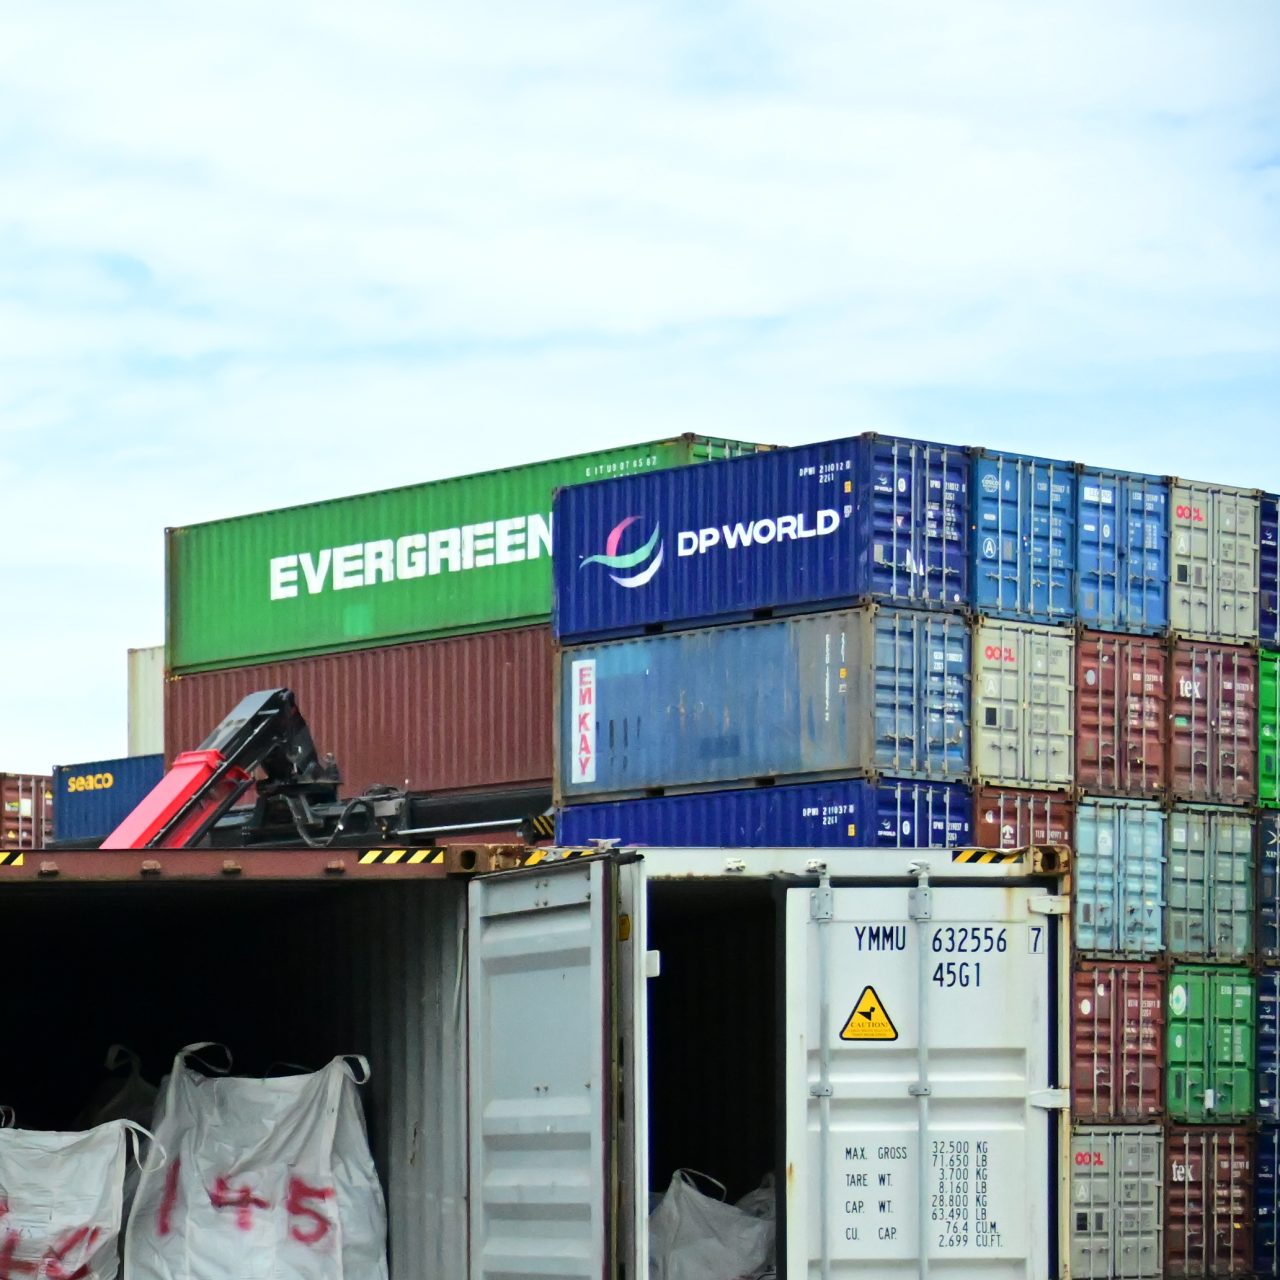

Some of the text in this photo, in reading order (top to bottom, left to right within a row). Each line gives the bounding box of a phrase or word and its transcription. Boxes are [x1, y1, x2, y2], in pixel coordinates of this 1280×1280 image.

[677, 508, 841, 557] DP WORLD
[270, 511, 553, 601] EVERGREEN
[984, 645, 1016, 663] OOCL
[1179, 675, 1201, 699] tex
[67, 772, 114, 793] seaco
[854, 925, 1042, 953] YMMU 632556 7
[932, 962, 981, 988] 45G1
[845, 1146, 908, 1160] MAX. GROSS
[932, 1141, 989, 1154] 32.500 KG
[932, 1154, 988, 1167] 71.650 LB
[939, 1168, 988, 1181] 3.700 KG
[1171, 1159, 1194, 1182] tex
[845, 1173, 893, 1187] TARE WT.
[938, 1181, 987, 1194] 8.160 LB
[845, 1200, 894, 1214] CAP. WT.
[931, 1194, 988, 1207] 28.800 KG
[931, 1208, 987, 1220] 63.490 LB
[845, 1227, 897, 1240] CU. CAP.
[938, 1234, 969, 1247] 2.699
